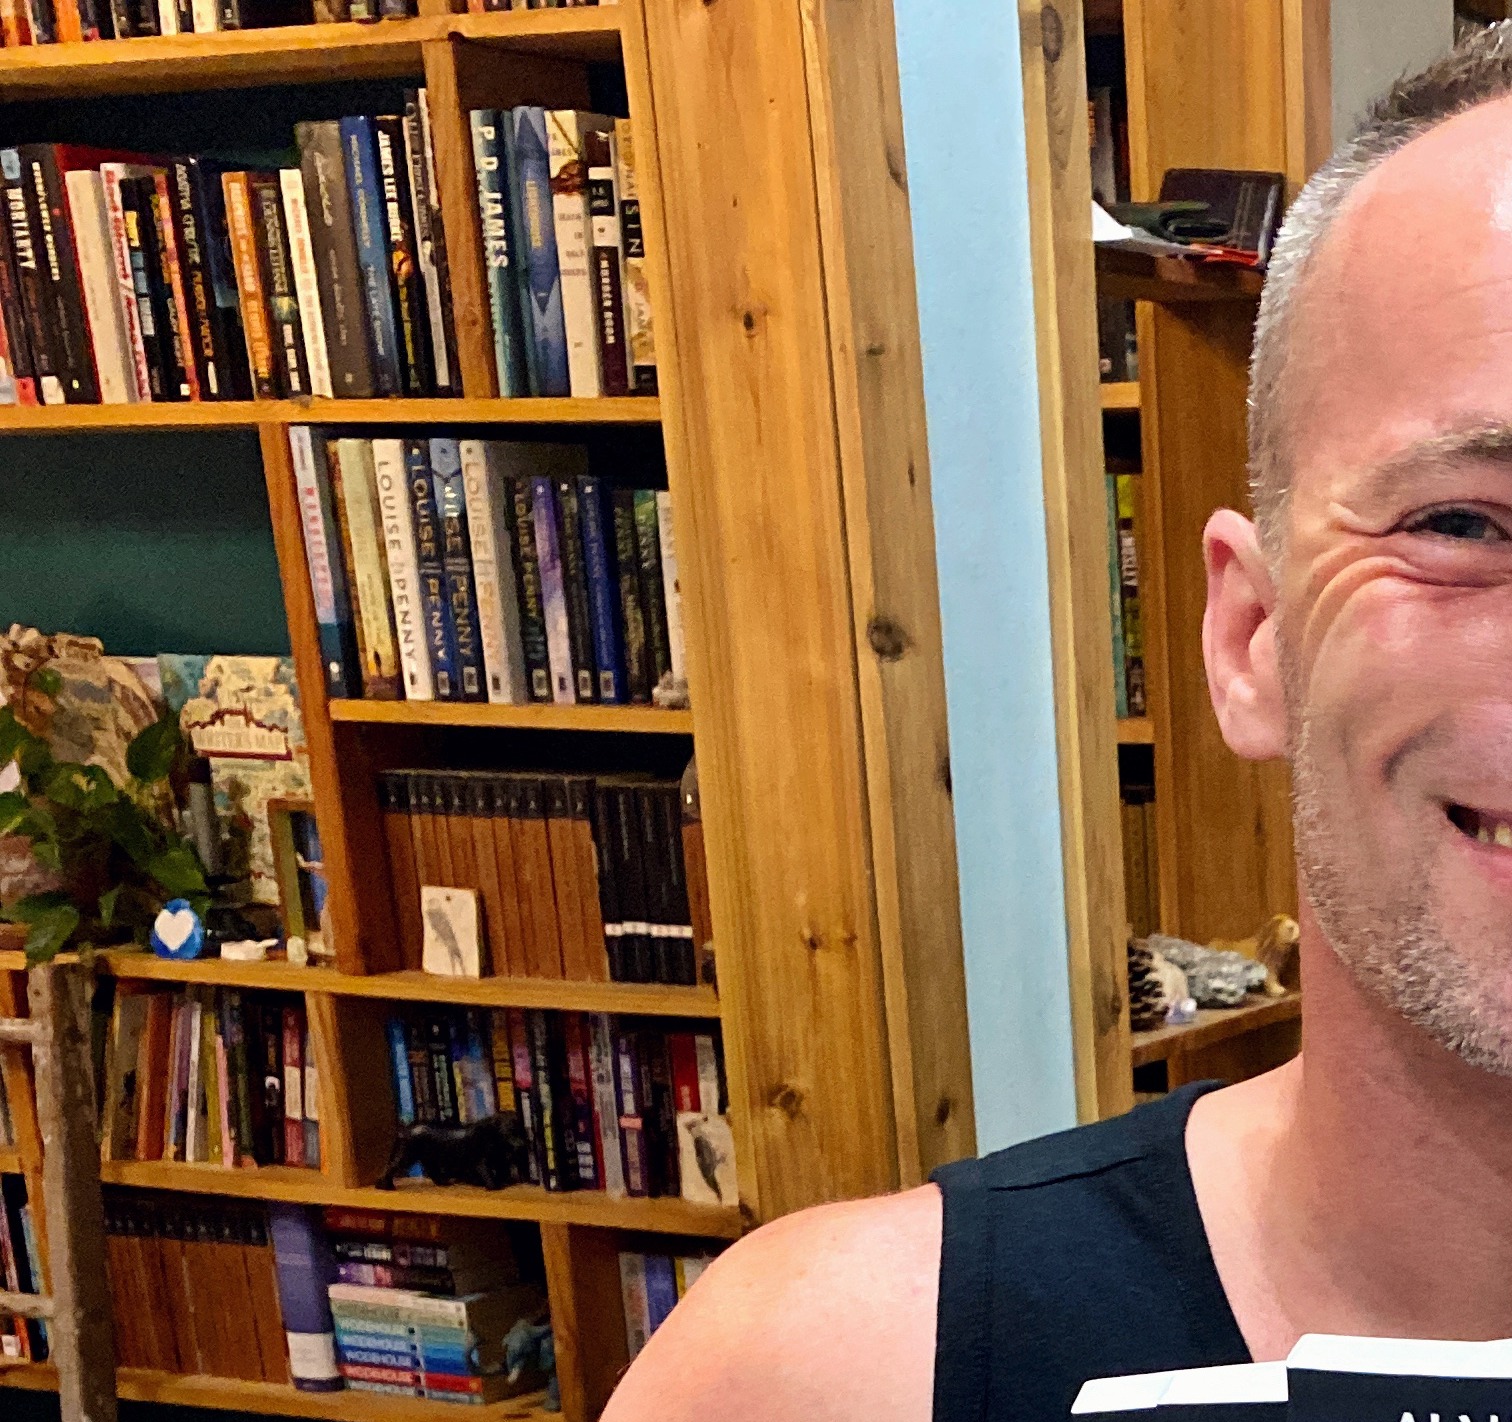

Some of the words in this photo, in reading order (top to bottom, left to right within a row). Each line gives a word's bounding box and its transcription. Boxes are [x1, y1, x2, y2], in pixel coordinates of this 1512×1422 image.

[378, 130, 394, 176] JAMES
[477, 125, 495, 141] P
[481, 156, 498, 171] D
[384, 177, 397, 200] LEE
[7, 187, 36, 270] MORIARTY
[484, 192, 508, 267] JAMES
[625, 205, 643, 255] SIN
[465, 461, 489, 554] LOUISE
[377, 460, 402, 552] LOUISE
[393, 574, 417, 663] PENNY
[411, 464, 437, 556] LOUISE
[426, 576, 448, 659] PENNY
[451, 575, 474, 657] PENNY
